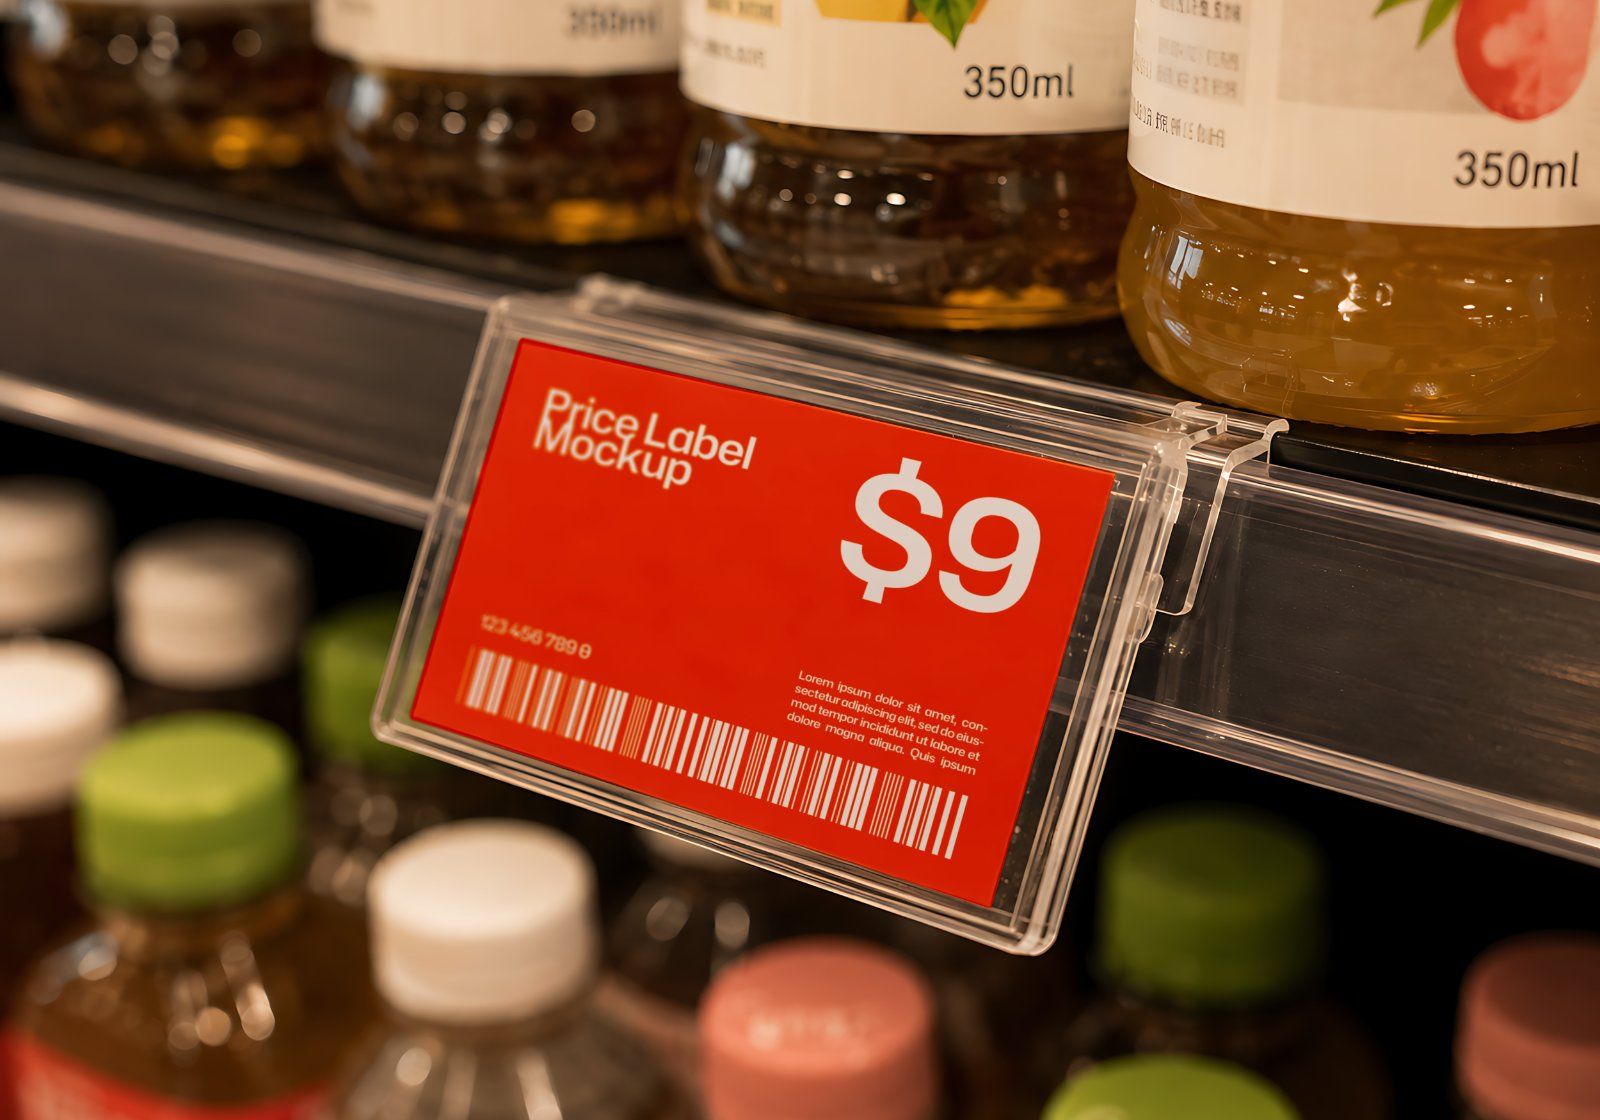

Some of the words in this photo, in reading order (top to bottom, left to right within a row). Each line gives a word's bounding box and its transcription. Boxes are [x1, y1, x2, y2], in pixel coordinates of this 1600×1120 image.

[963, 62, 1075, 99] 350ml
[1455, 149, 1580, 190] 350ml
[533, 415, 693, 490] Mockup
[545, 387, 639, 437] Price
[643, 412, 757, 470] Label
[840, 456, 1041, 614] $9
[481, 614, 508, 635] 123
[509, 623, 543, 645] 456
[545, 632, 577, 655] 789
[791, 699, 817, 713] mod
[818, 706, 859, 723] tempor
[860, 717, 914, 742] incididunt
[915, 735, 929, 746] ut
[930, 738, 966, 757] labore
[967, 751, 980, 762] et
[795, 685, 841, 705] sectetur
[841, 699, 897, 723] adipiscing
[897, 715, 917, 730] elit,
[918, 721, 940, 734] sed
[940, 727, 955, 739] do
[956, 732, 984, 746] eius-
[798, 670, 834, 689] Lorem
[837, 681, 872, 700] ipsum
[875, 693, 904, 708] dolor
[907, 703, 921, 714] sit
[925, 708, 957, 727] amet,
[961, 719, 988, 732] con-
[787, 712, 821, 729] dolore
[825, 724, 865, 742] magna
[869, 736, 905, 755] aliqua.
[910, 747, 936, 764] Quis
[940, 757, 977, 776] ipsum
